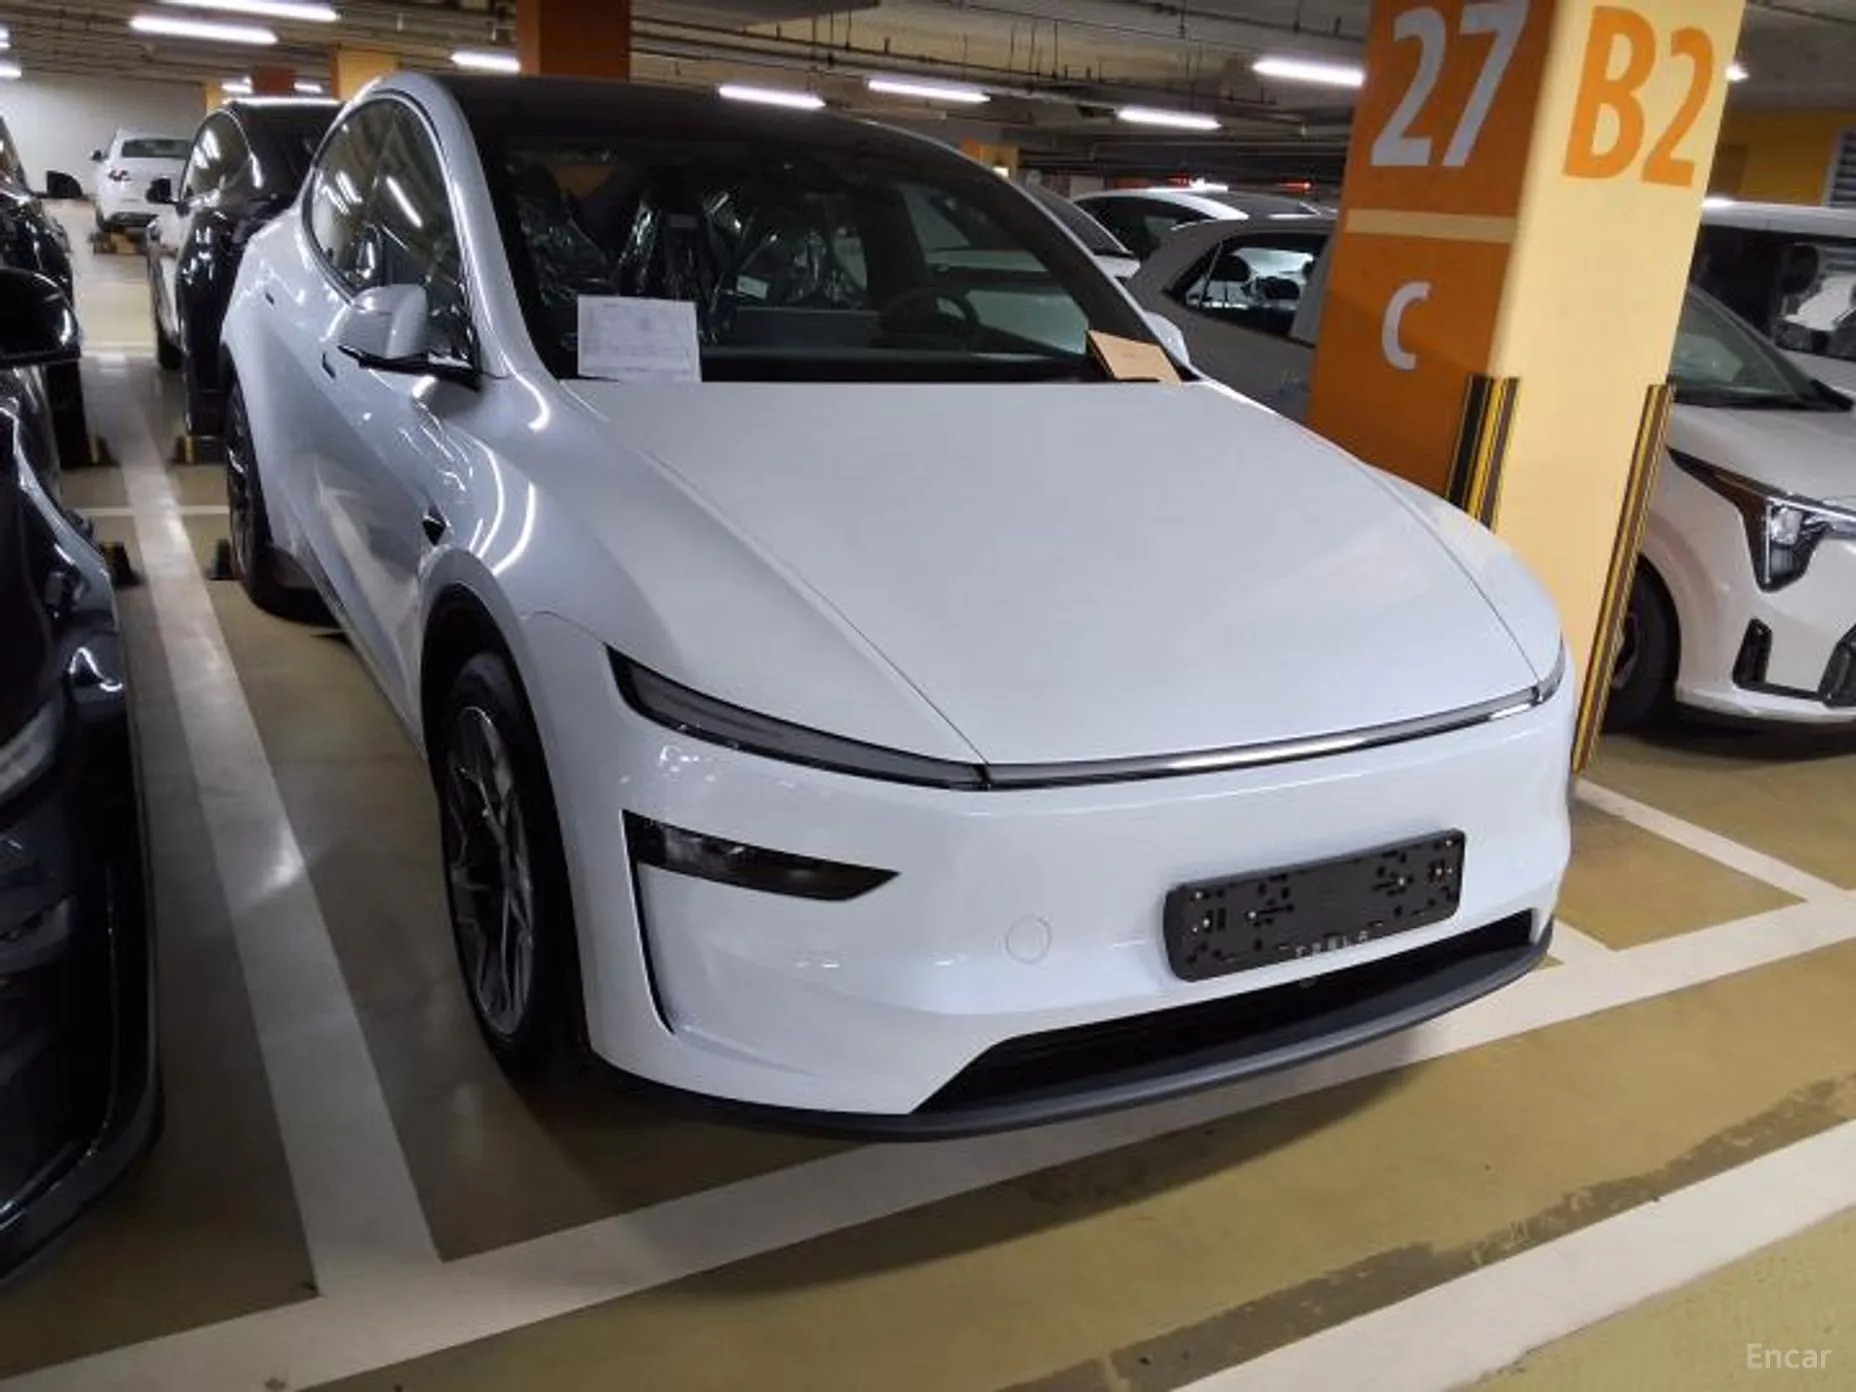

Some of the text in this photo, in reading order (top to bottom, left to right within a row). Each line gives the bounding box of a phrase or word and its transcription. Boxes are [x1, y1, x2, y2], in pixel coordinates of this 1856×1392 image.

[1370, 1, 1529, 167] 27
[1562, 6, 1714, 187] B2
[1381, 281, 1431, 370] C
